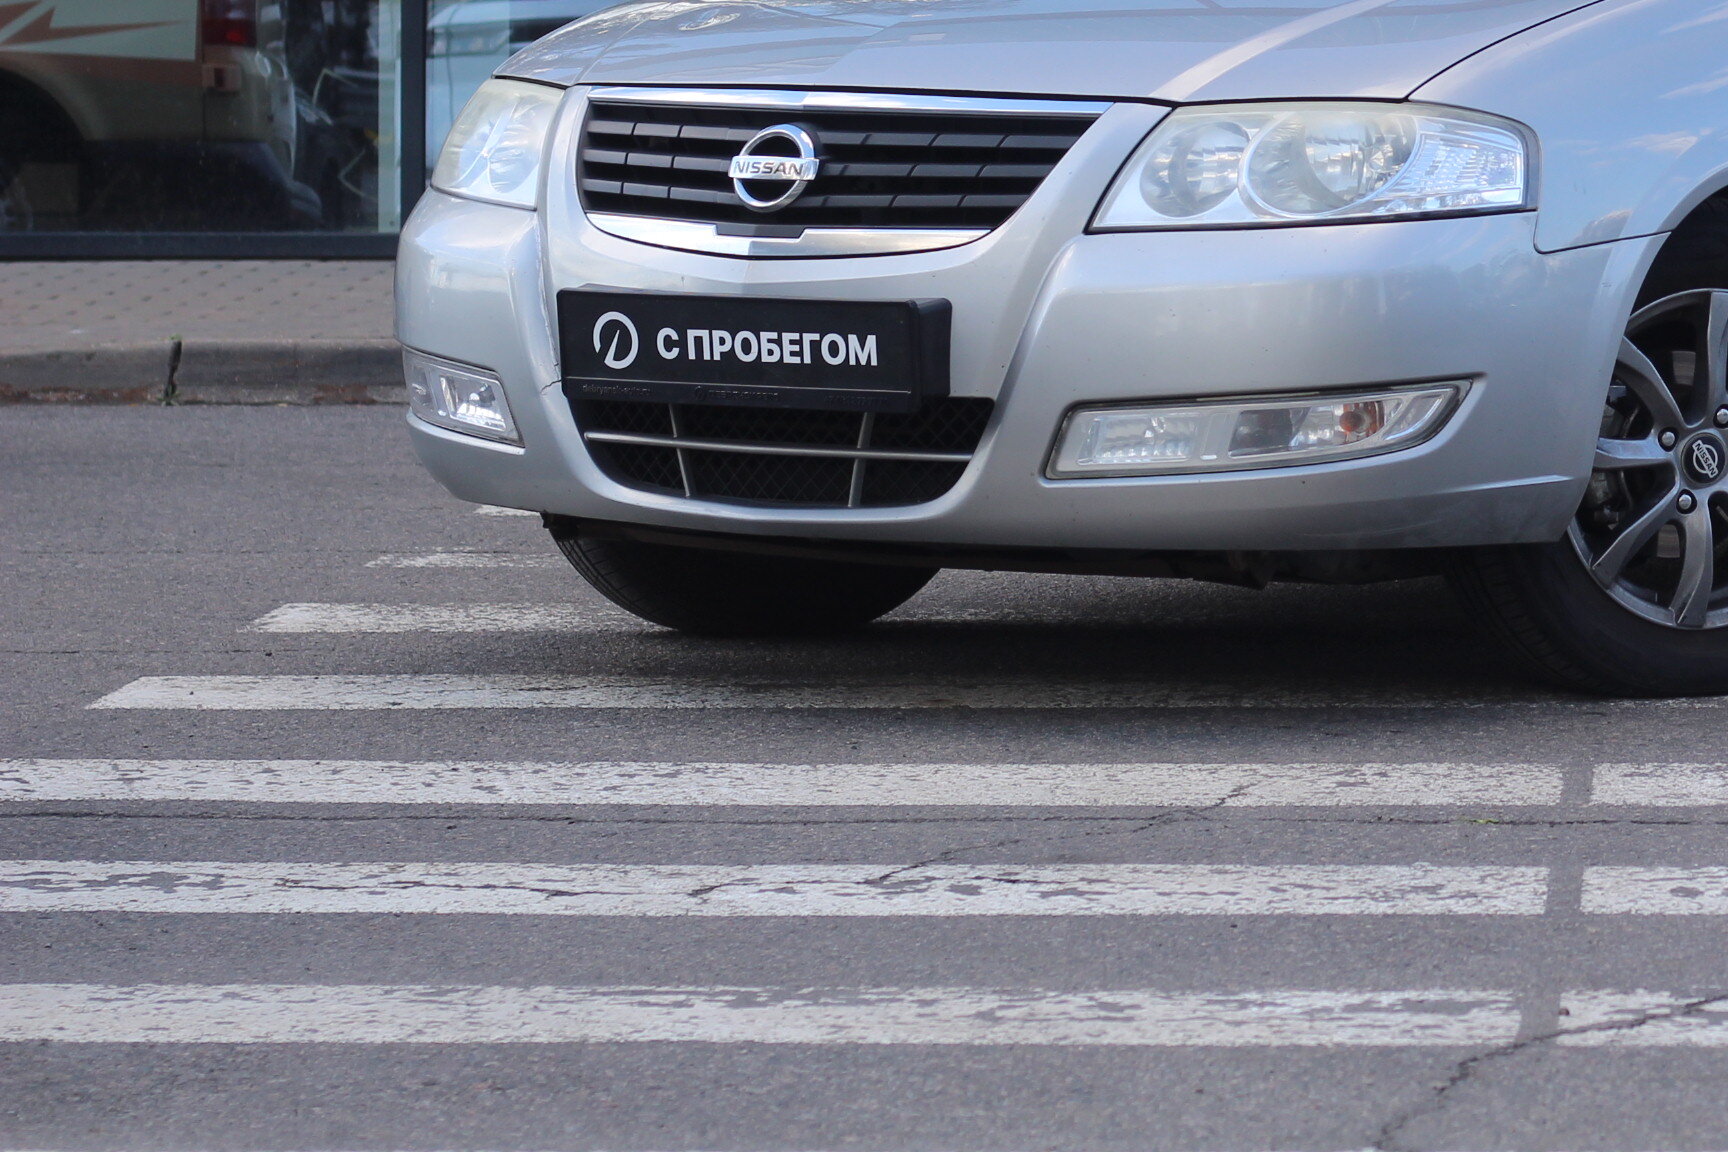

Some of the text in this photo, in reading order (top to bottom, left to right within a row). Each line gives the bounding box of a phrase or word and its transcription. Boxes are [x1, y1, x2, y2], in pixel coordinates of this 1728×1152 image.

[734, 160, 804, 177] NISSAN
[656, 327, 878, 366] С ПРОБЕГОМ
[1694, 442, 1717, 477] NISSAN
